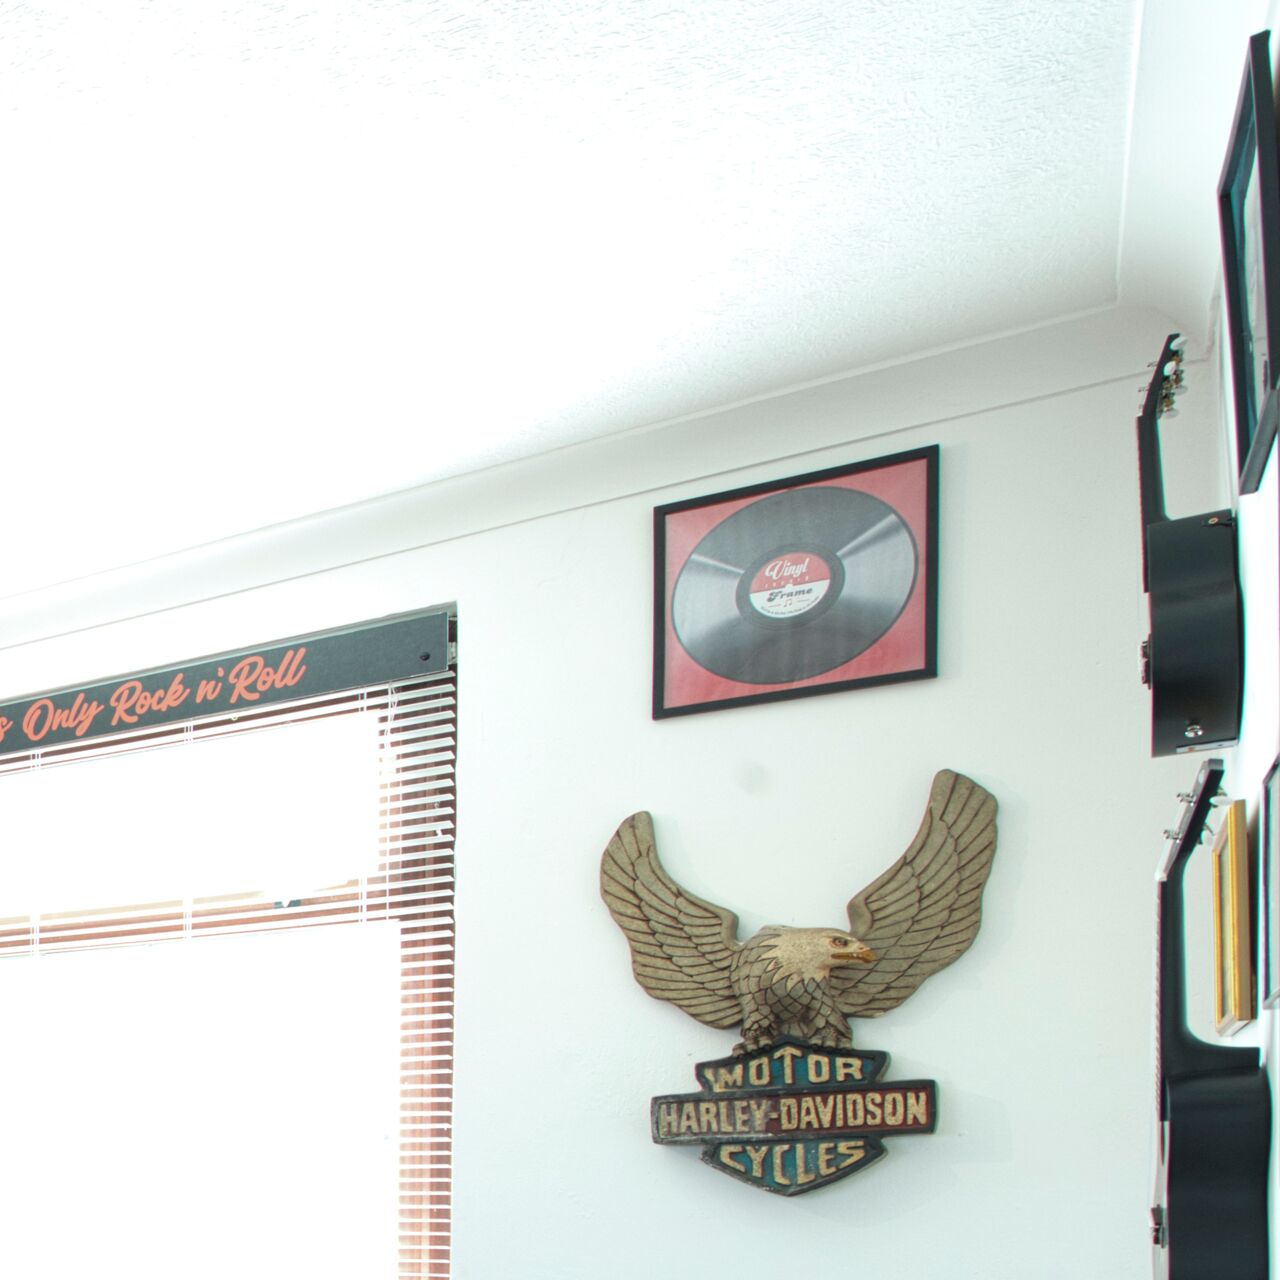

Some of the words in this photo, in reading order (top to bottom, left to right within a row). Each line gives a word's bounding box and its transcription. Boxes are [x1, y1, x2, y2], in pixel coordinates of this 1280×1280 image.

[764, 557, 810, 580] Vinyl
[766, 587, 813, 602] Frame
[23, 693, 104, 740] Only
[110, 673, 190, 726] Rock
[704, 1046, 864, 1093] MOTOR
[659, 1092, 928, 1138] HARLEY-DAVIDSON
[719, 1140, 866, 1186] CYCLES
